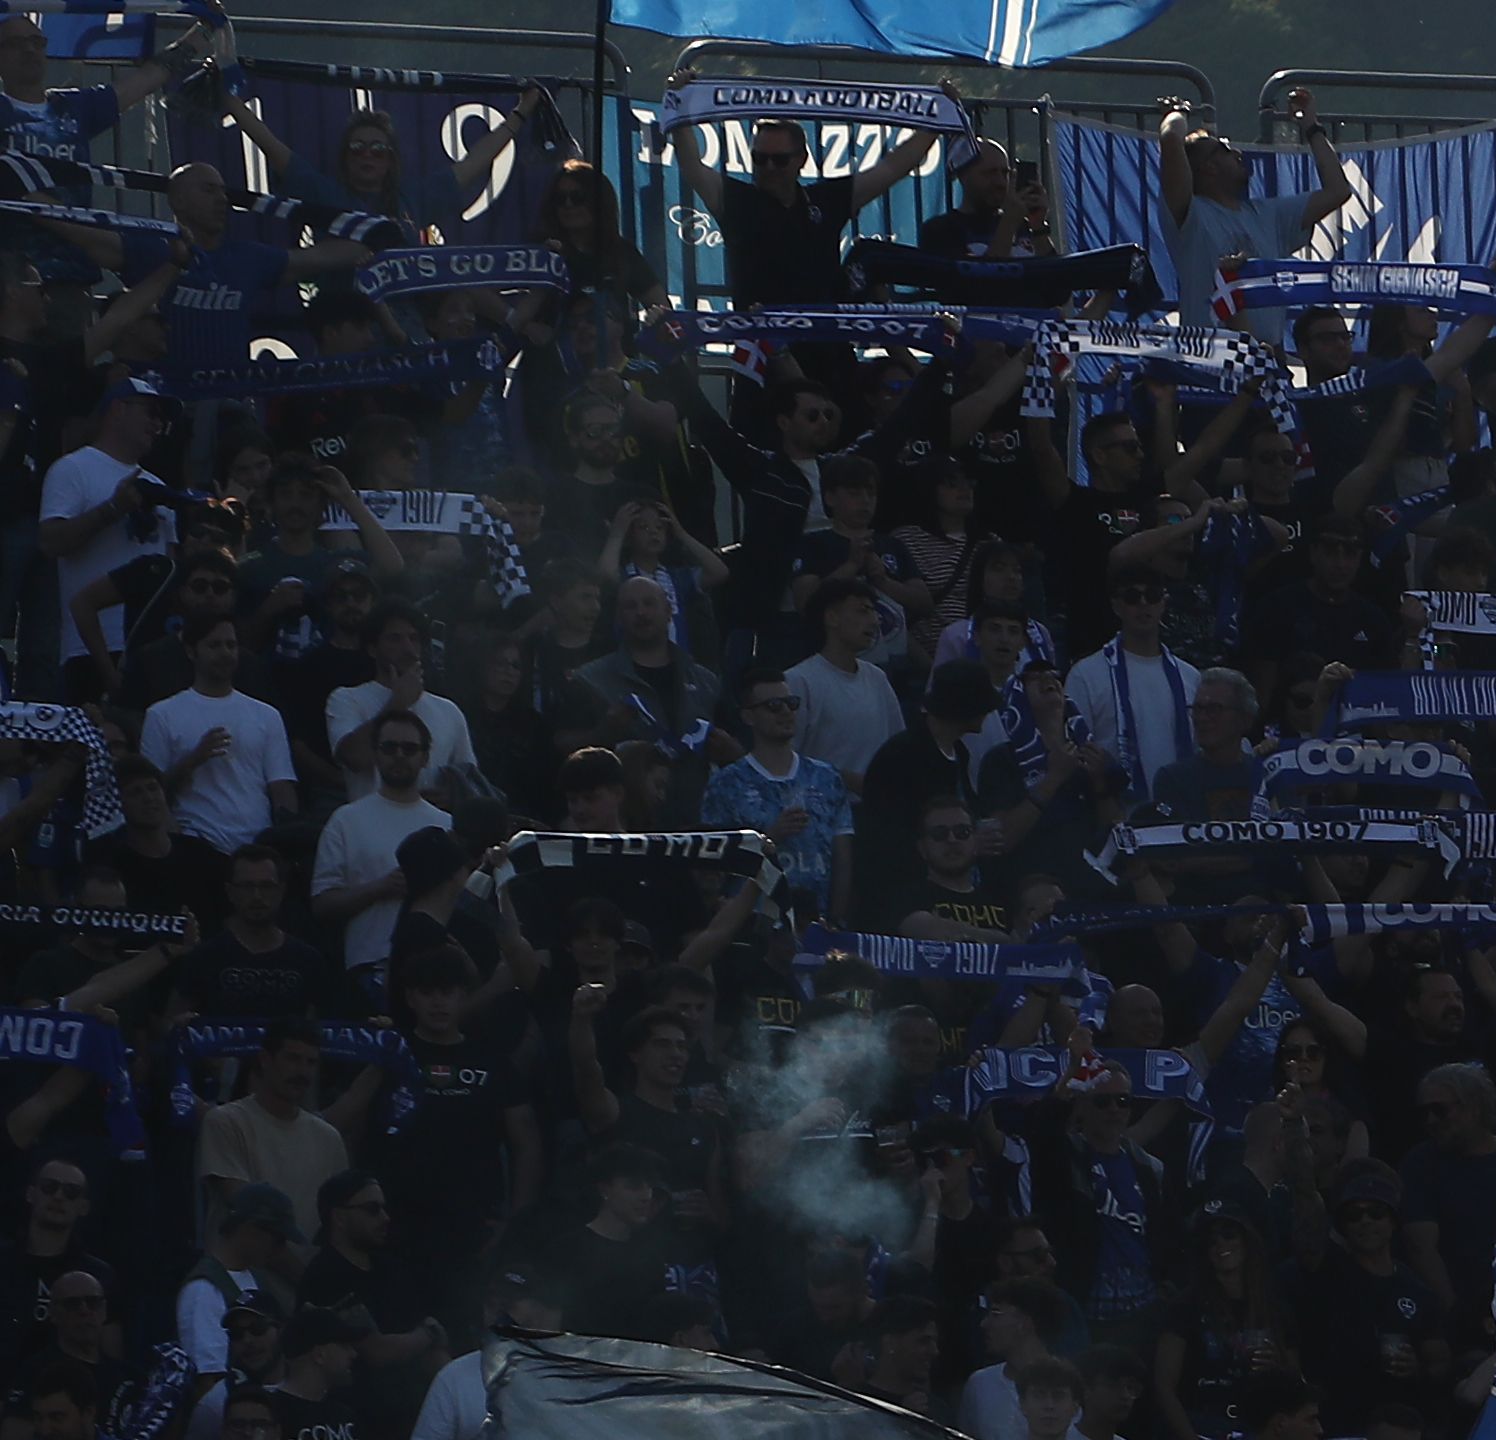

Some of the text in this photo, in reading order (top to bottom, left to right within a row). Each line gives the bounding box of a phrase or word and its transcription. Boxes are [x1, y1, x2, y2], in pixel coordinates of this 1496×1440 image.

[356, 253, 438, 298] LET'S
[450, 251, 496, 276] GO
[172, 282, 242, 310] mita
[1088, 319, 1216, 359] COMO 1907
[401, 492, 447, 525] 1907
[1295, 738, 1442, 778] COMO
[586, 834, 730, 859] COMO
[1182, 819, 1370, 843] COMO 1907
[857, 932, 1000, 975] COMO 1907
